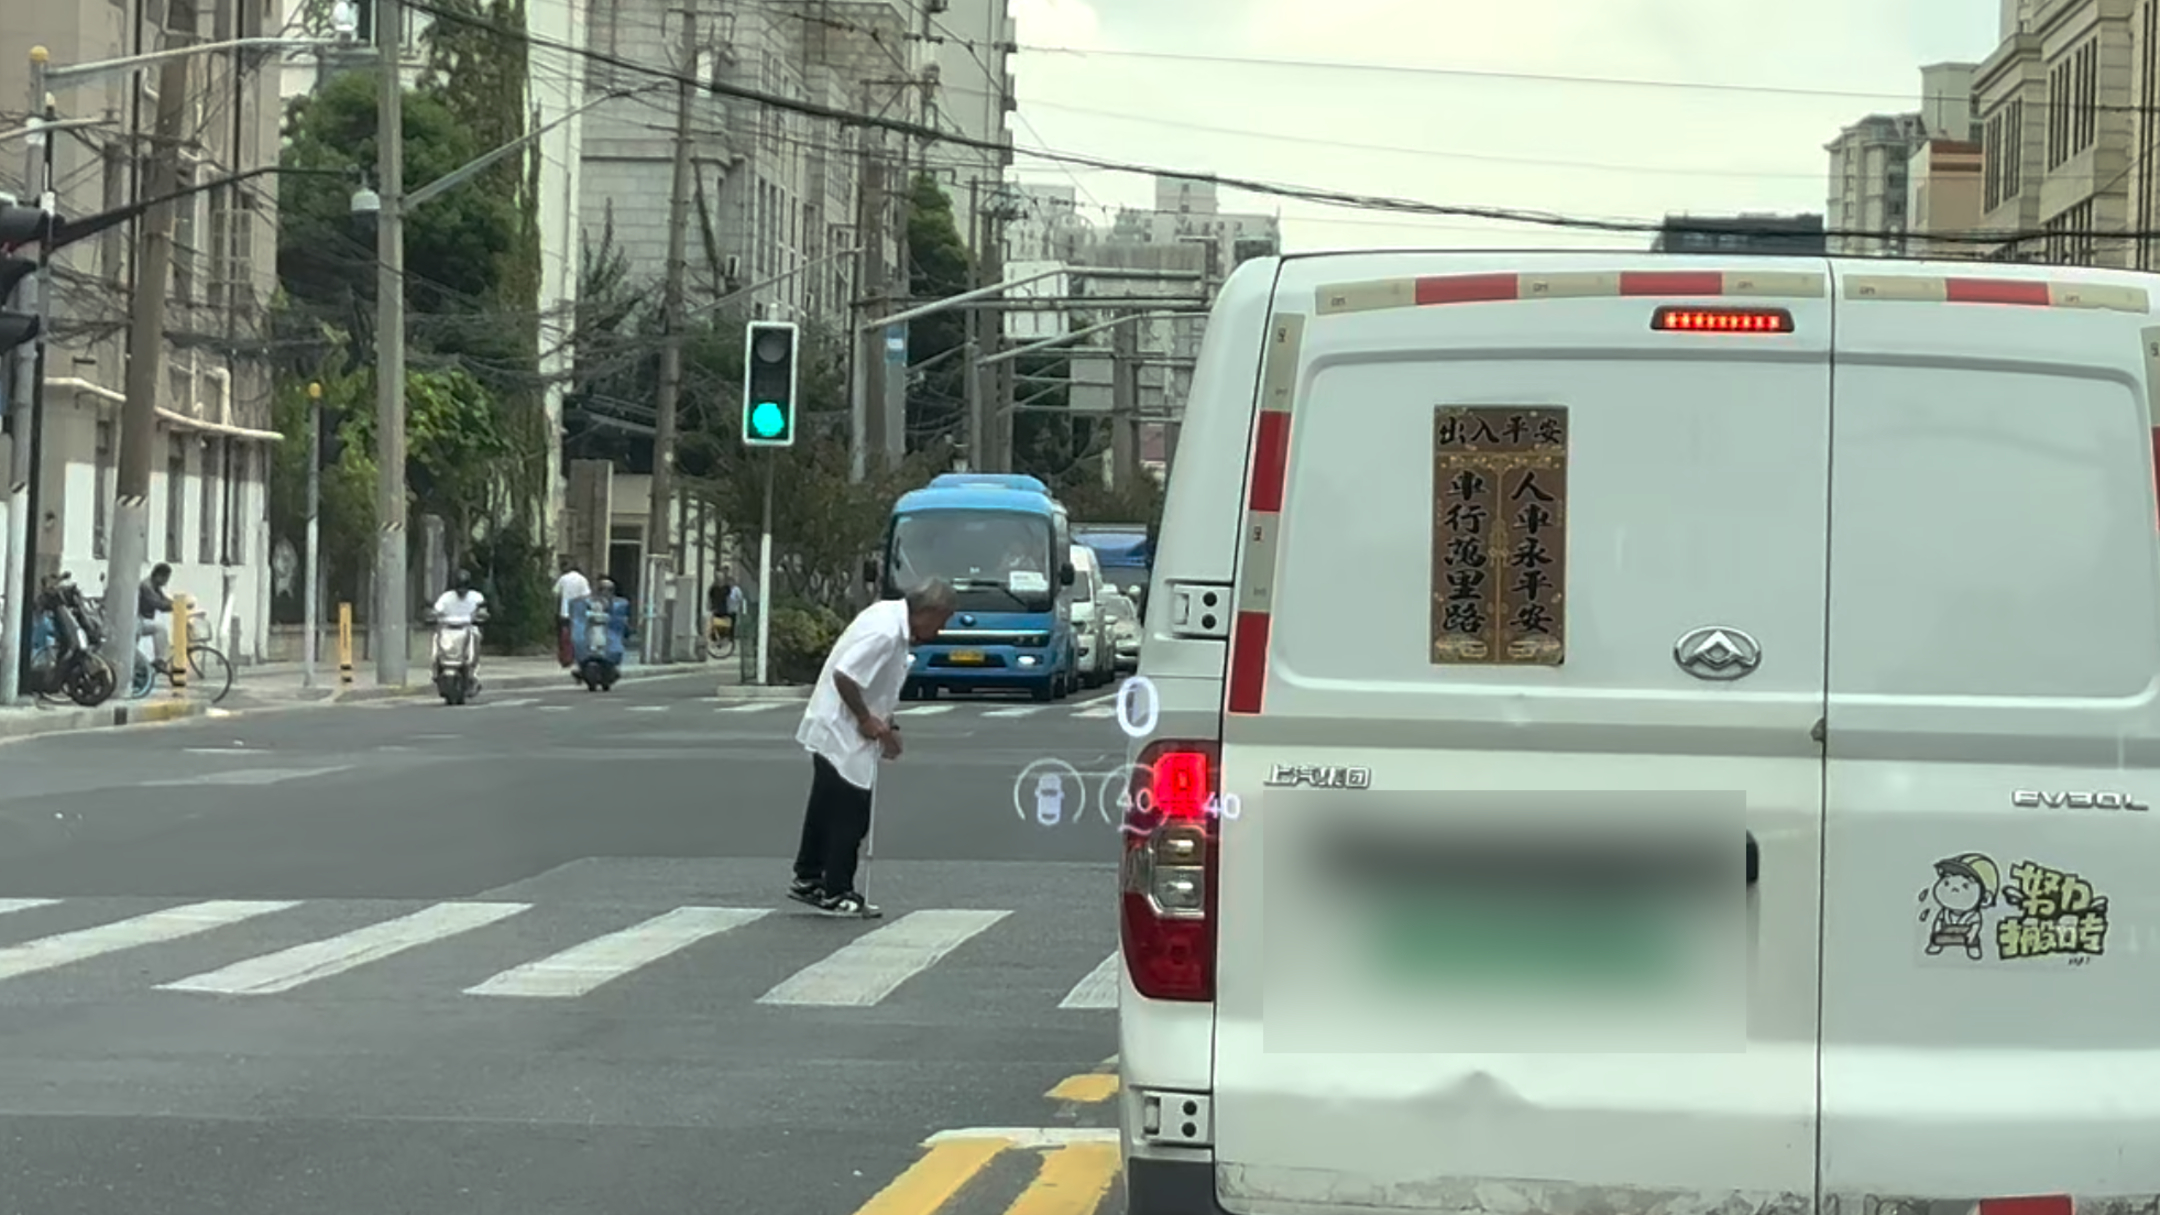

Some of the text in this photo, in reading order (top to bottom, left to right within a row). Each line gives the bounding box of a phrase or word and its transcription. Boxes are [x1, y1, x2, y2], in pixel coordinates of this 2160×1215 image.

[1439, 416, 1562, 445] 出入平安
[1117, 676, 1159, 737] 0
[1116, 788, 1153, 812] 40
[1203, 791, 1241, 820] 40
